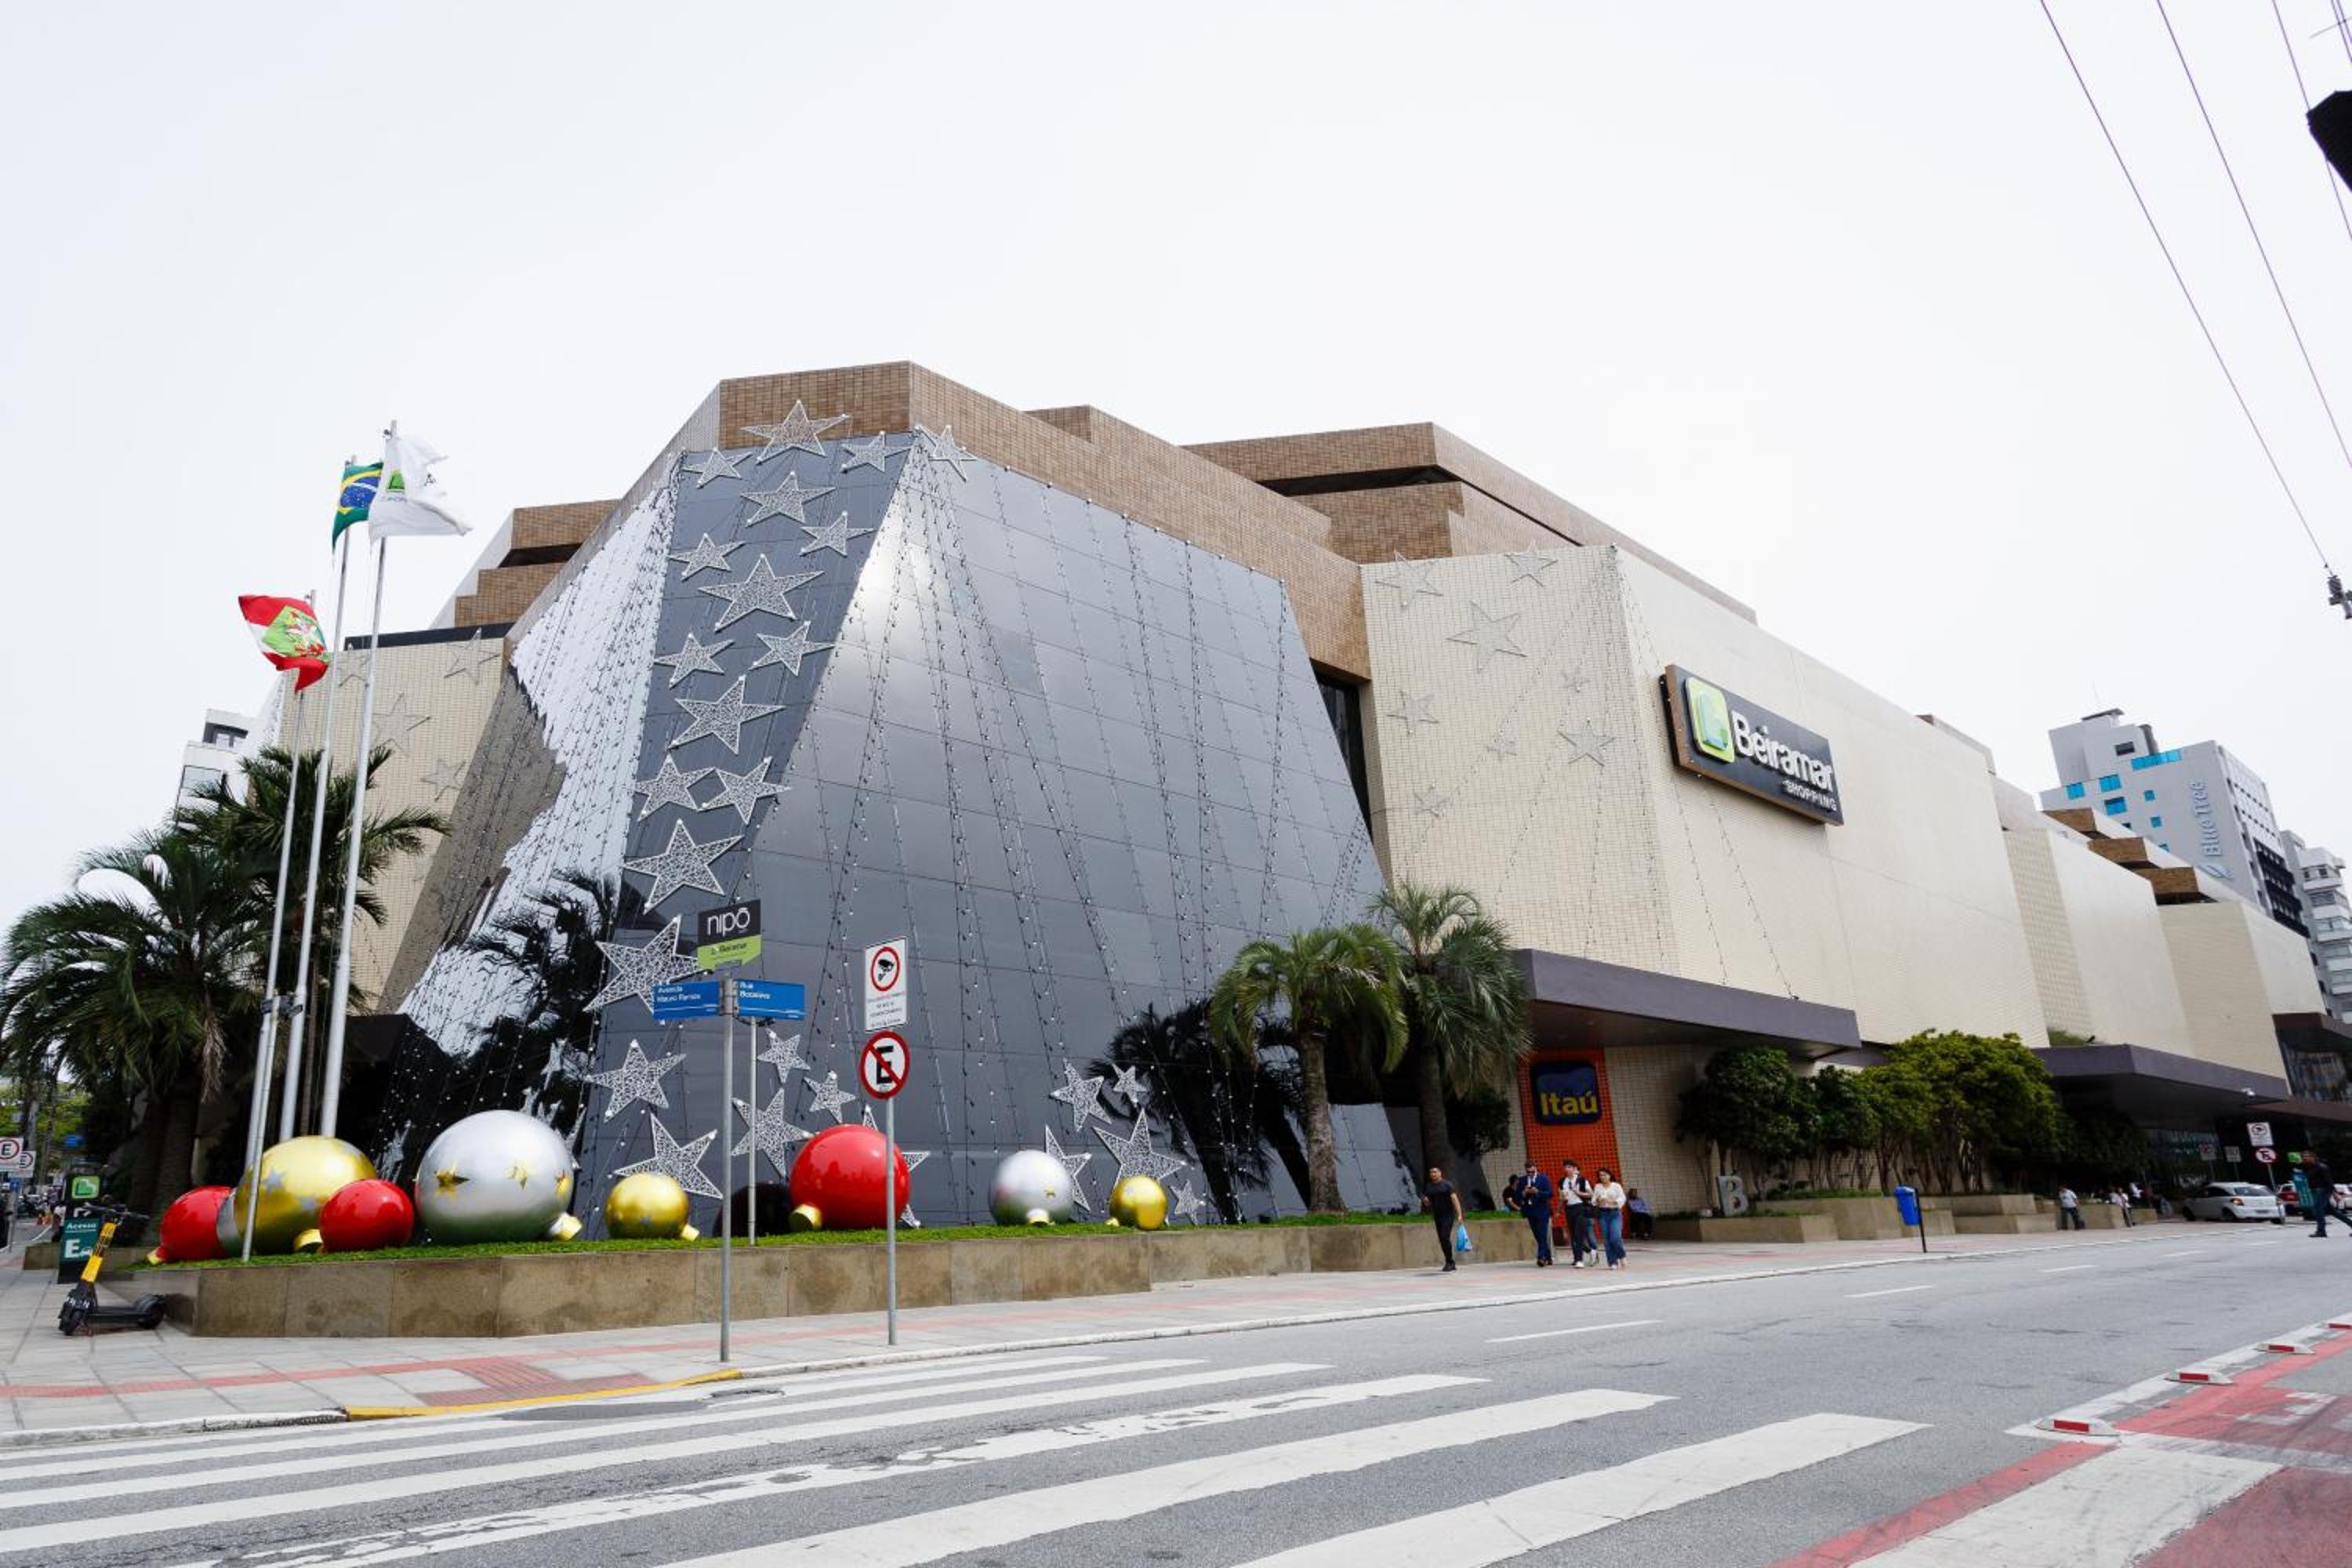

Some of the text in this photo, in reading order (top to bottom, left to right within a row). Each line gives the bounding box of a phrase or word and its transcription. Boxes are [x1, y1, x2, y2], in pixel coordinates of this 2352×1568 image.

[1731, 709, 1834, 792] Beiramar
[1782, 779, 1837, 811] SHOPPING
[1541, 1091, 1599, 1116] Itaú
[2, 1144, 12, 1156] E
[1718, 1175, 1749, 1216] B
[66, 1221, 96, 1230] Acesso
[64, 1238, 81, 1258] E
